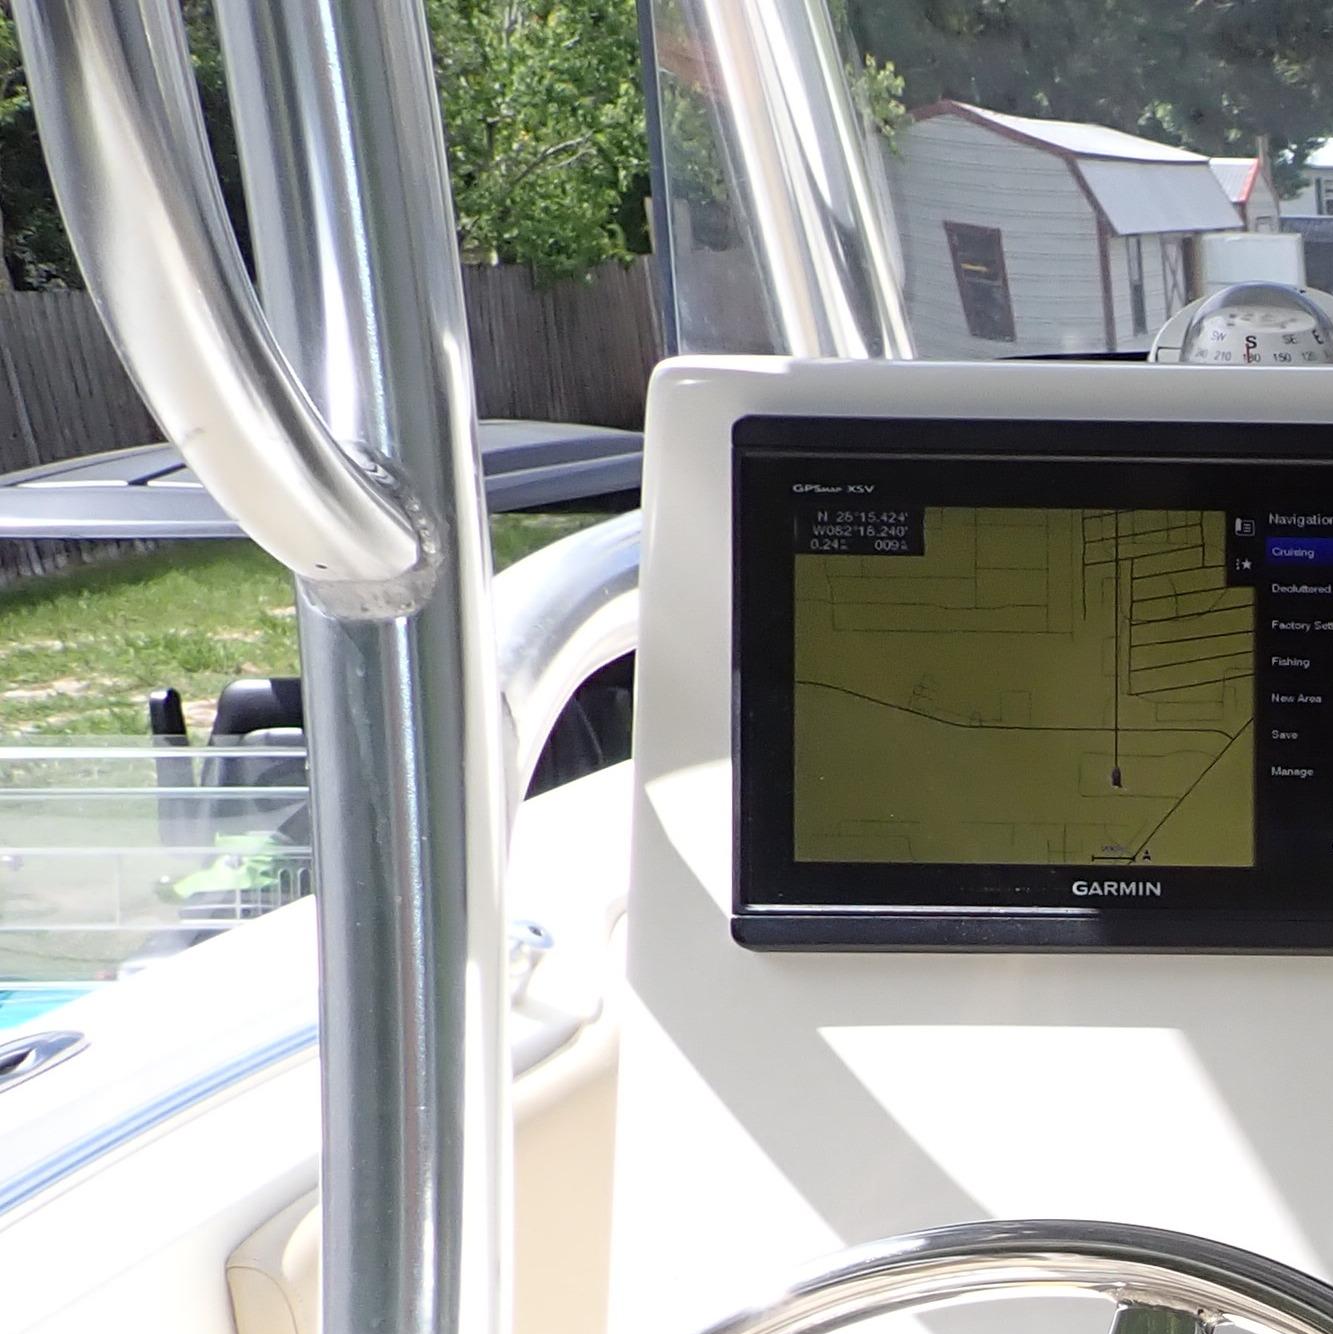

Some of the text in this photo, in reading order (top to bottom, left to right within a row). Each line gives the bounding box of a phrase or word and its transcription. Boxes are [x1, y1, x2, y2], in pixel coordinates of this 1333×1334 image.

[1245, 335, 1258, 349] S
[1213, 350, 1232, 362] 210
[1273, 352, 1292, 363] 150
[1271, 547, 1316, 560] Cruising
[1271, 583, 1332, 594] Decluttered
[1271, 620, 1311, 632] Factory
[1271, 656, 1311, 669] Fishing
[1271, 693, 1322, 703] New Area
[1271, 730, 1299, 739] Save
[1271, 767, 1315, 778] Manage
[1071, 881, 1162, 896] GARMIN
